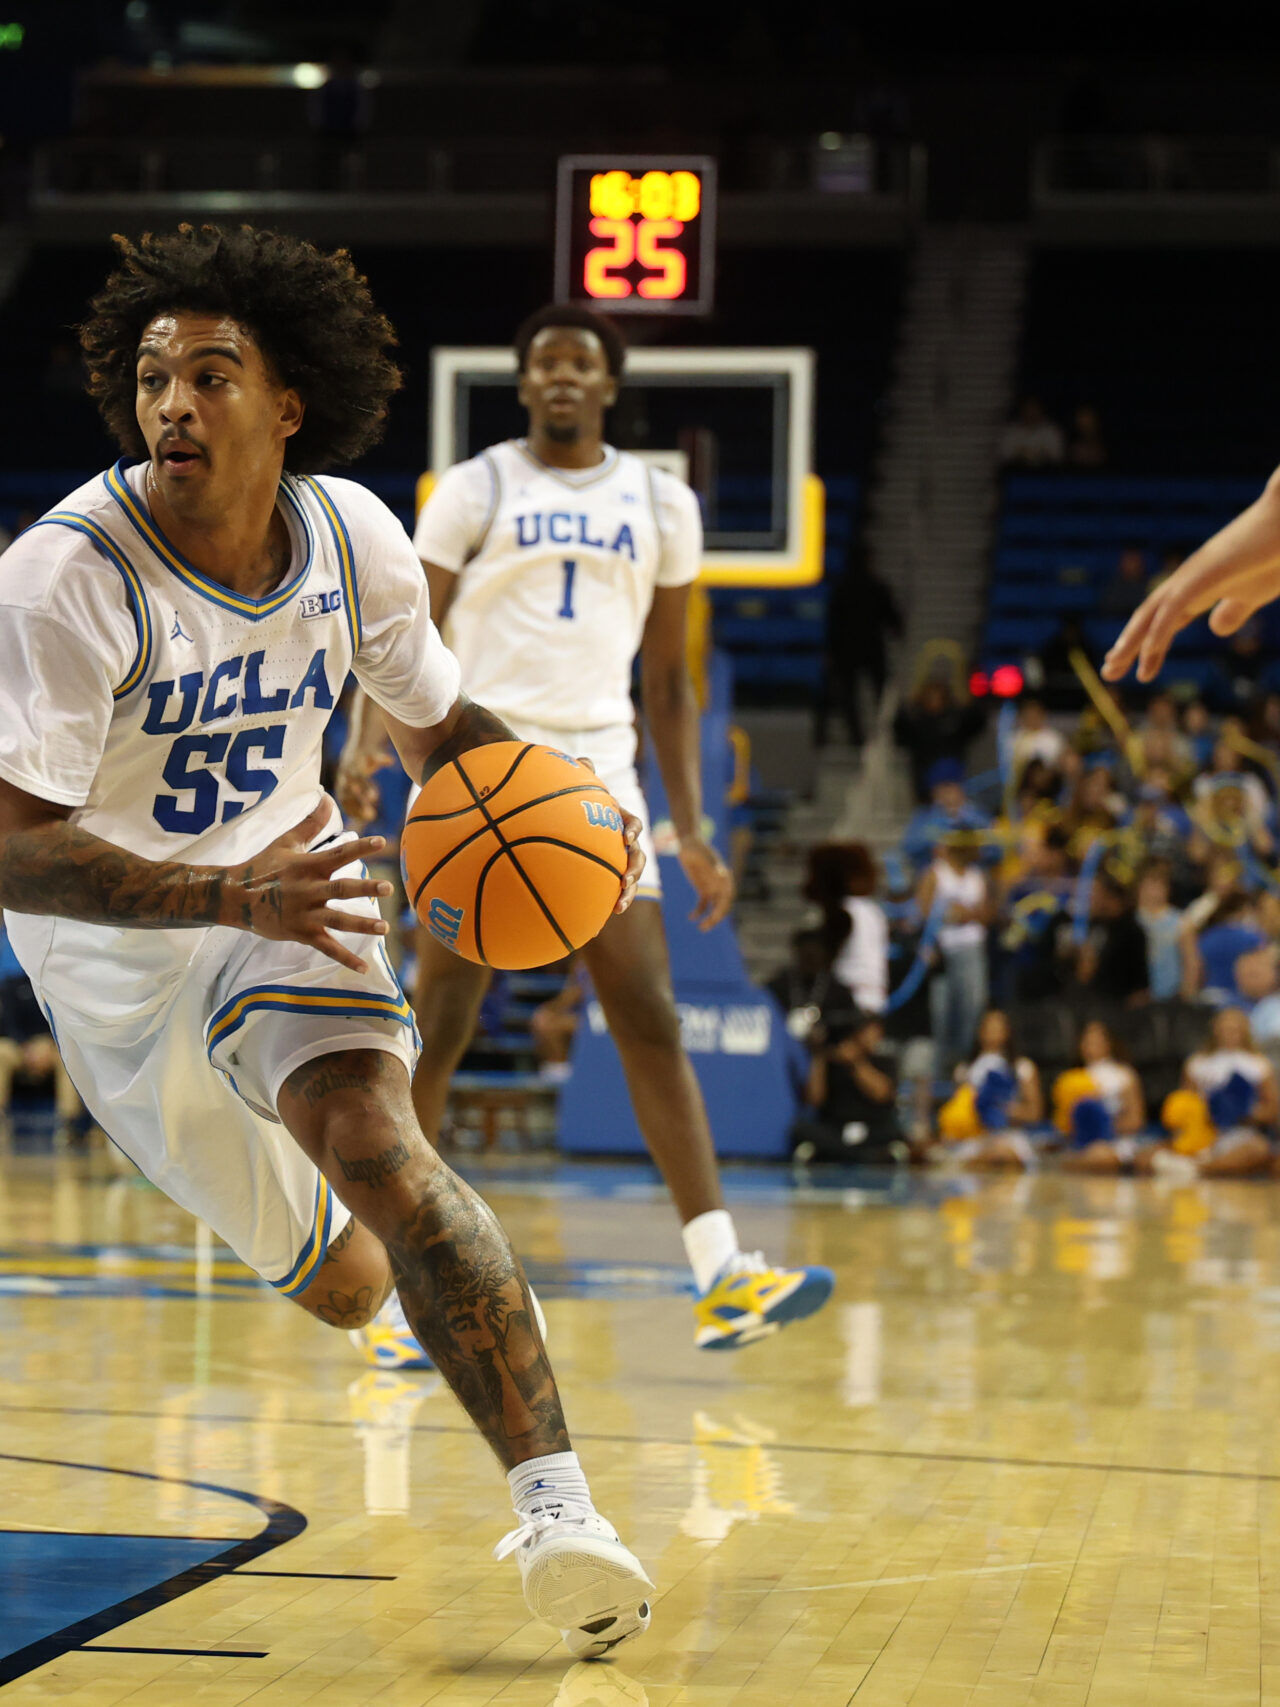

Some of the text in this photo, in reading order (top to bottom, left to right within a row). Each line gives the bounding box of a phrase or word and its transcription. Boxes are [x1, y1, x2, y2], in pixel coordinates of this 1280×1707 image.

[583, 217, 687, 299] 25
[515, 512, 637, 562] UCLA
[558, 560, 576, 619] 1
[141, 648, 334, 735] UCLA
[332, 1128, 411, 1189] happened
